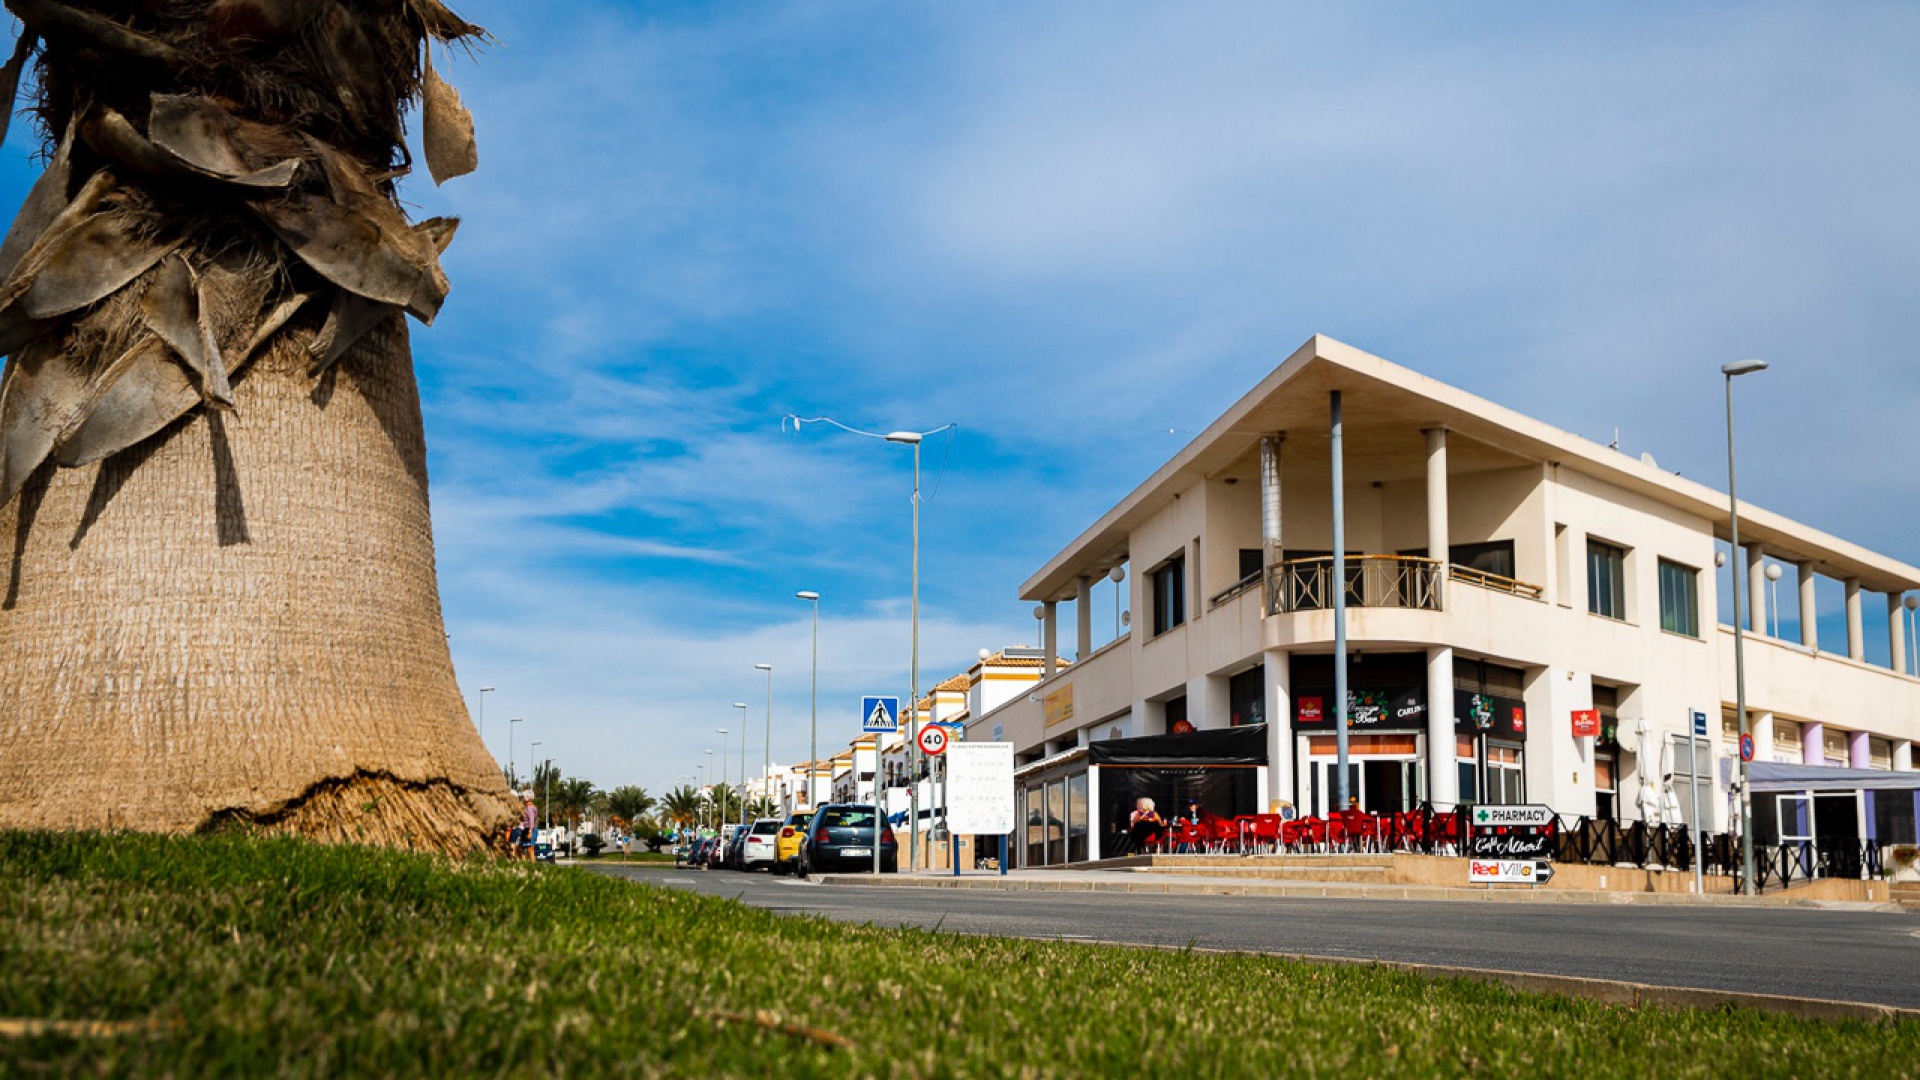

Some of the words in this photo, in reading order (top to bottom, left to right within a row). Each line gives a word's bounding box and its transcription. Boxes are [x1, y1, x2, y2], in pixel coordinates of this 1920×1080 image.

[924, 734, 943, 745] 40
[1492, 810, 1546, 821] PHARMACY
[1472, 861, 1499, 876] Red
[1501, 862, 1532, 877] Villa
